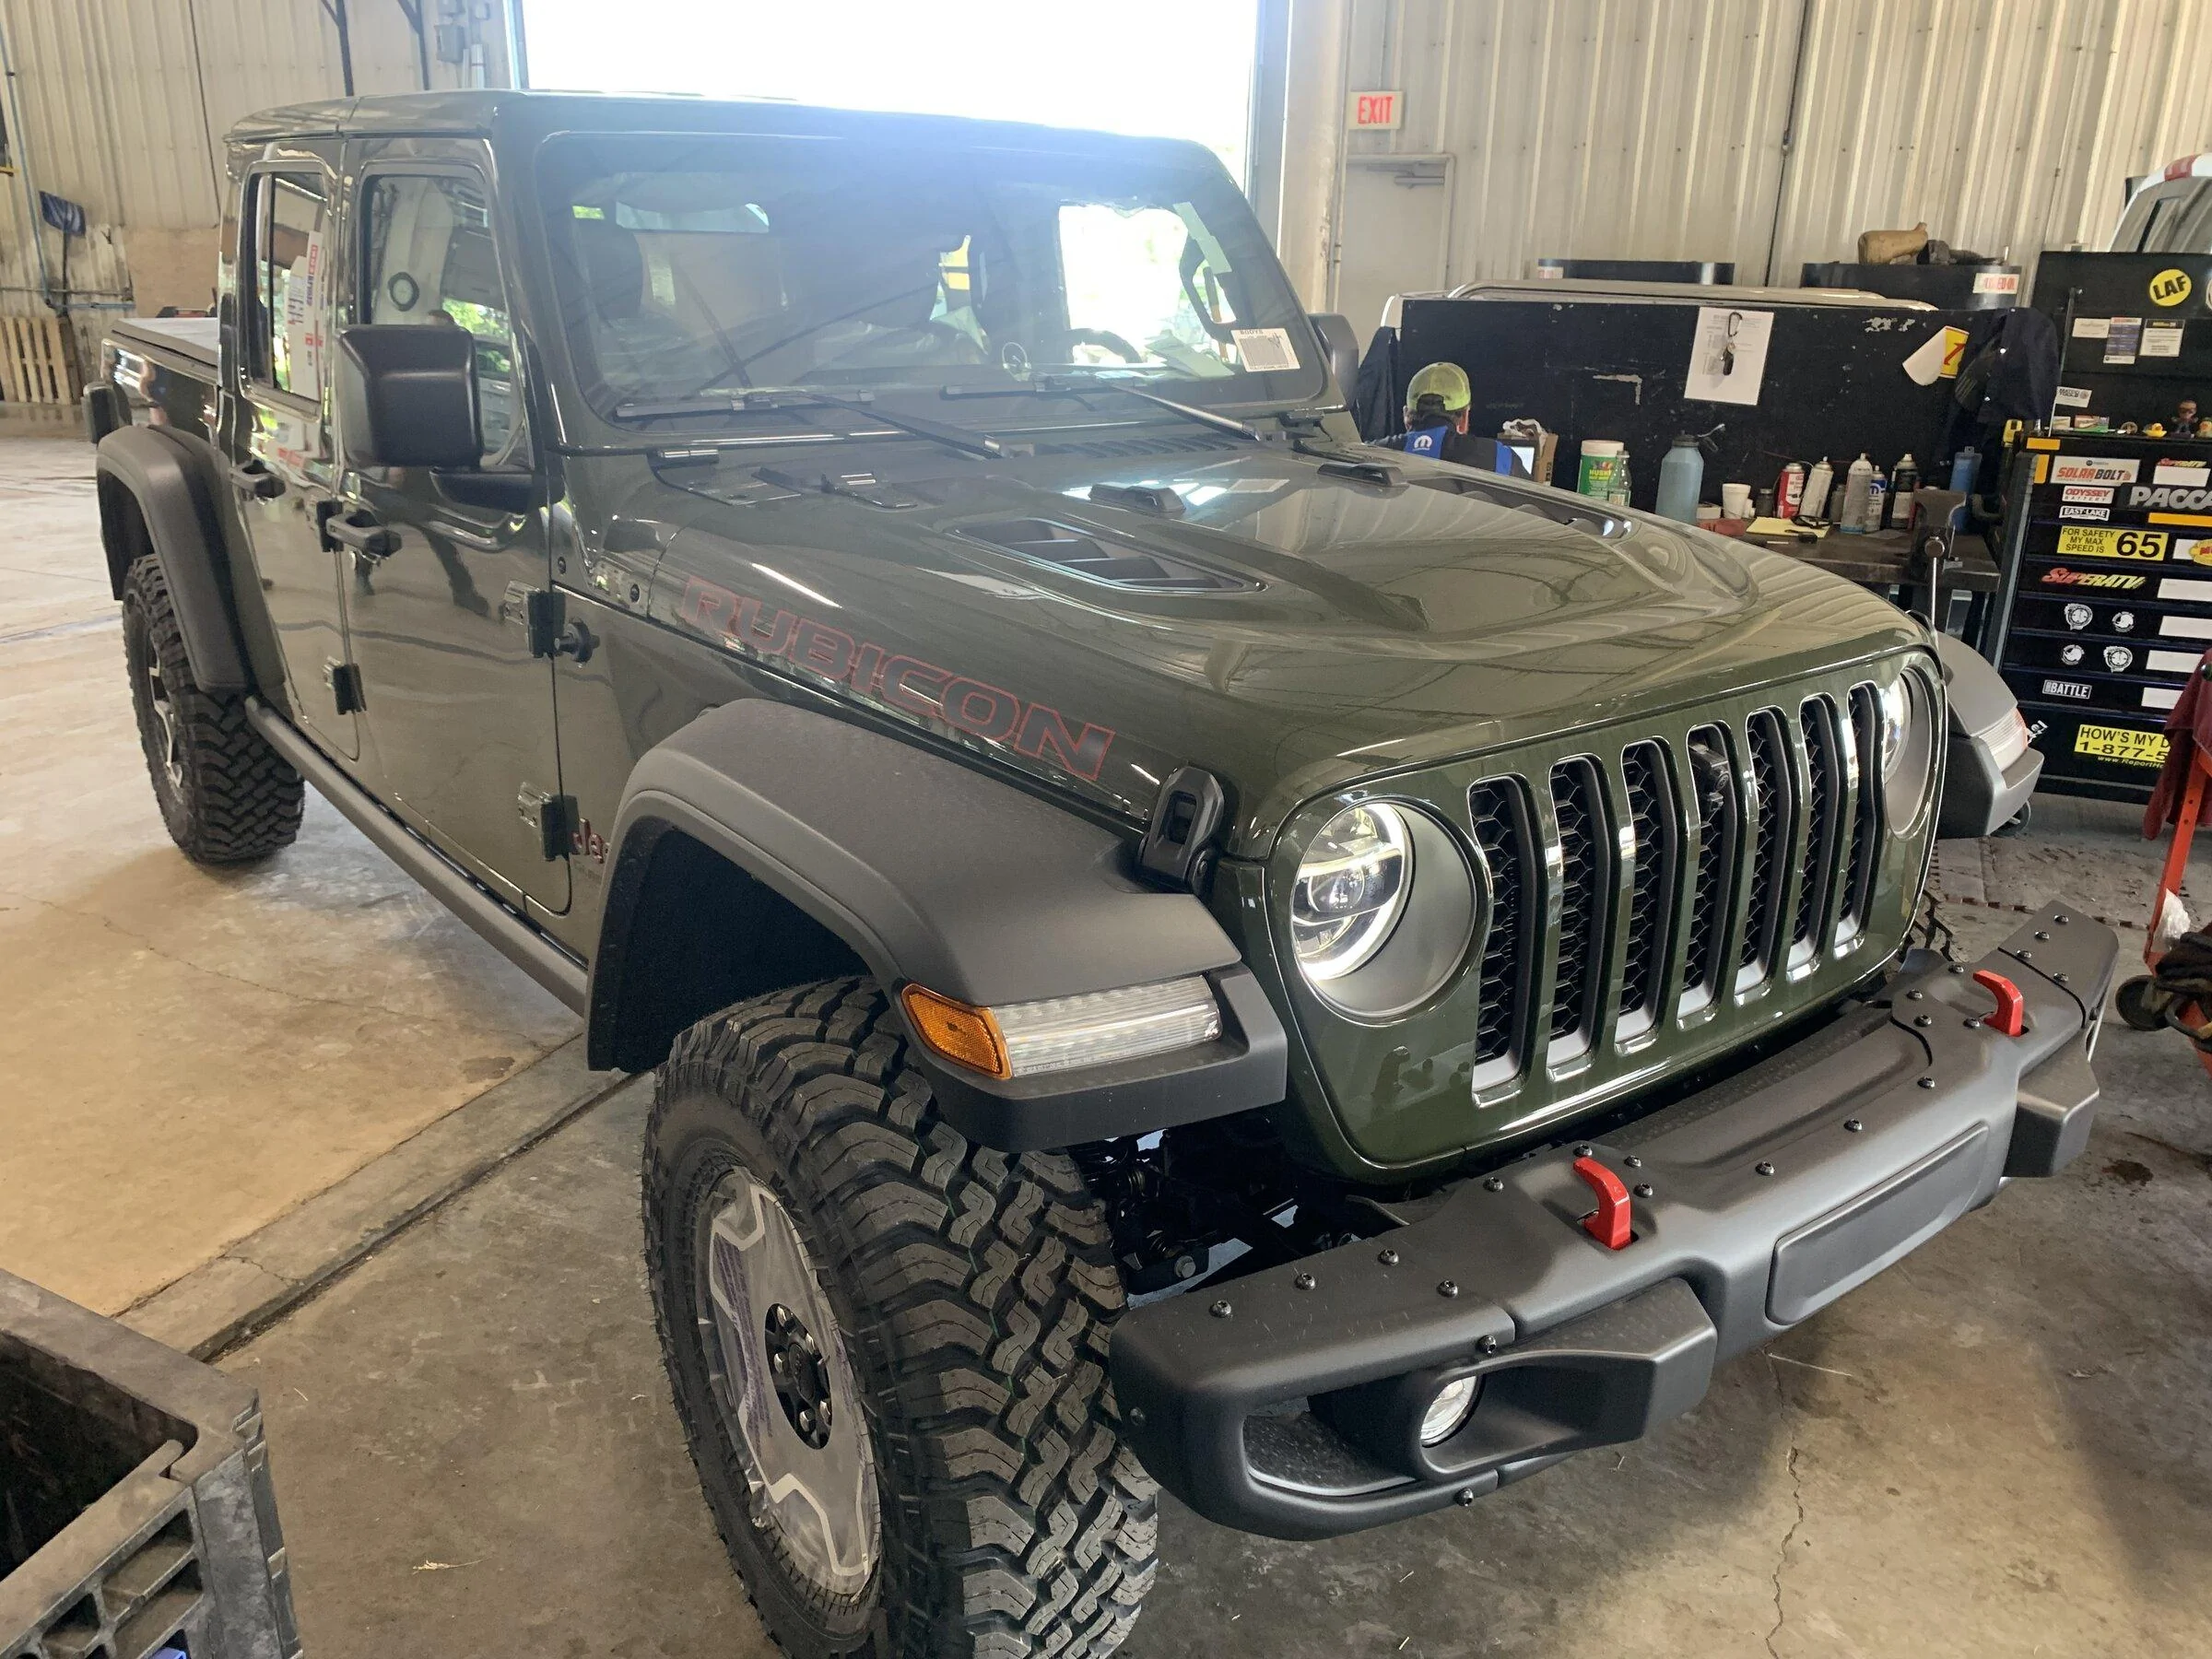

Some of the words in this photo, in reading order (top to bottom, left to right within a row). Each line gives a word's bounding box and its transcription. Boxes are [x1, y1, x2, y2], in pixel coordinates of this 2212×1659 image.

[1358, 96, 1394, 124] EXIT
[2153, 275, 2186, 300] LAF
[2065, 488, 2111, 497] ODYSSEY
[2082, 529, 2115, 538] SAFETY
[2085, 537, 2104, 546] MAX
[2065, 544, 2094, 553] SPEED
[2116, 532, 2161, 558] 65
[682, 574, 1116, 782] RUBICON
[2051, 682, 2089, 698] BATTLE
[2080, 726, 2130, 743] HOW'S
[2134, 733, 2157, 746] MY
[2079, 741, 2169, 761] 1-877-5
